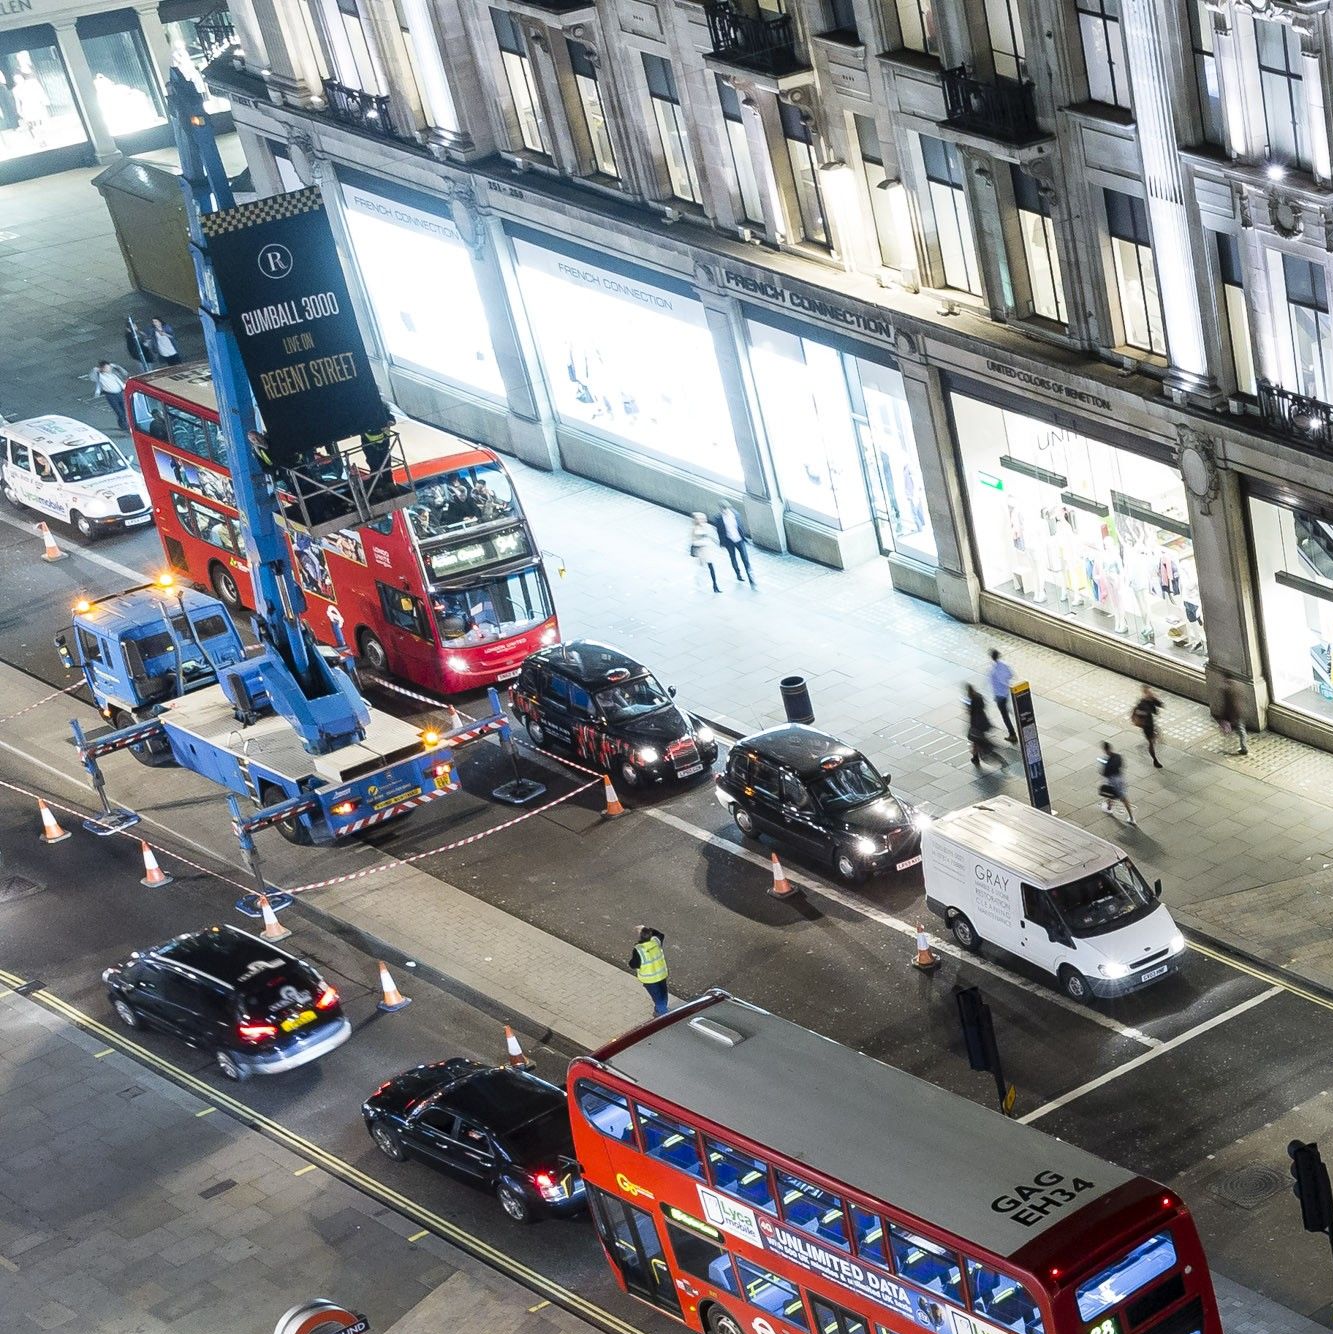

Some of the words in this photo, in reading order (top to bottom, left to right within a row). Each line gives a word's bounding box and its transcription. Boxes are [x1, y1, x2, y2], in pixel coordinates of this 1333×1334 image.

[354, 195, 393, 218] FRENCH
[395, 208, 460, 240] CONNECTION
[266, 251, 288, 272] R
[558, 262, 600, 286] FRENCH
[603, 275, 673, 310] CONNECTION
[724, 270, 786, 303] FRENCH
[789, 292, 891, 338] CONNECTION
[241, 300, 303, 336] GUMBALL
[301, 291, 340, 321] 3000
[282, 335, 300, 354] LIVE
[300, 331, 315, 351] ON
[260, 363, 310, 401] REGENT
[309, 352, 358, 388] STREET
[986, 360, 1016, 379] UNITED
[1017, 371, 1051, 391] COLORS
[1051, 382, 1064, 395] OF
[974, 864, 1010, 891] GRAY
[721, 1200, 753, 1226] Lyca
[990, 1170, 1065, 1215] GAG
[1009, 1177, 1096, 1228] EH34
[724, 1217, 757, 1238] mobile
[774, 1227, 864, 1282] UNLIMITED
[867, 1273, 911, 1306] DATA
[798, 1251, 810, 1264] UK
[810, 1260, 839, 1279] minutes
[881, 1291, 893, 1303] UK
